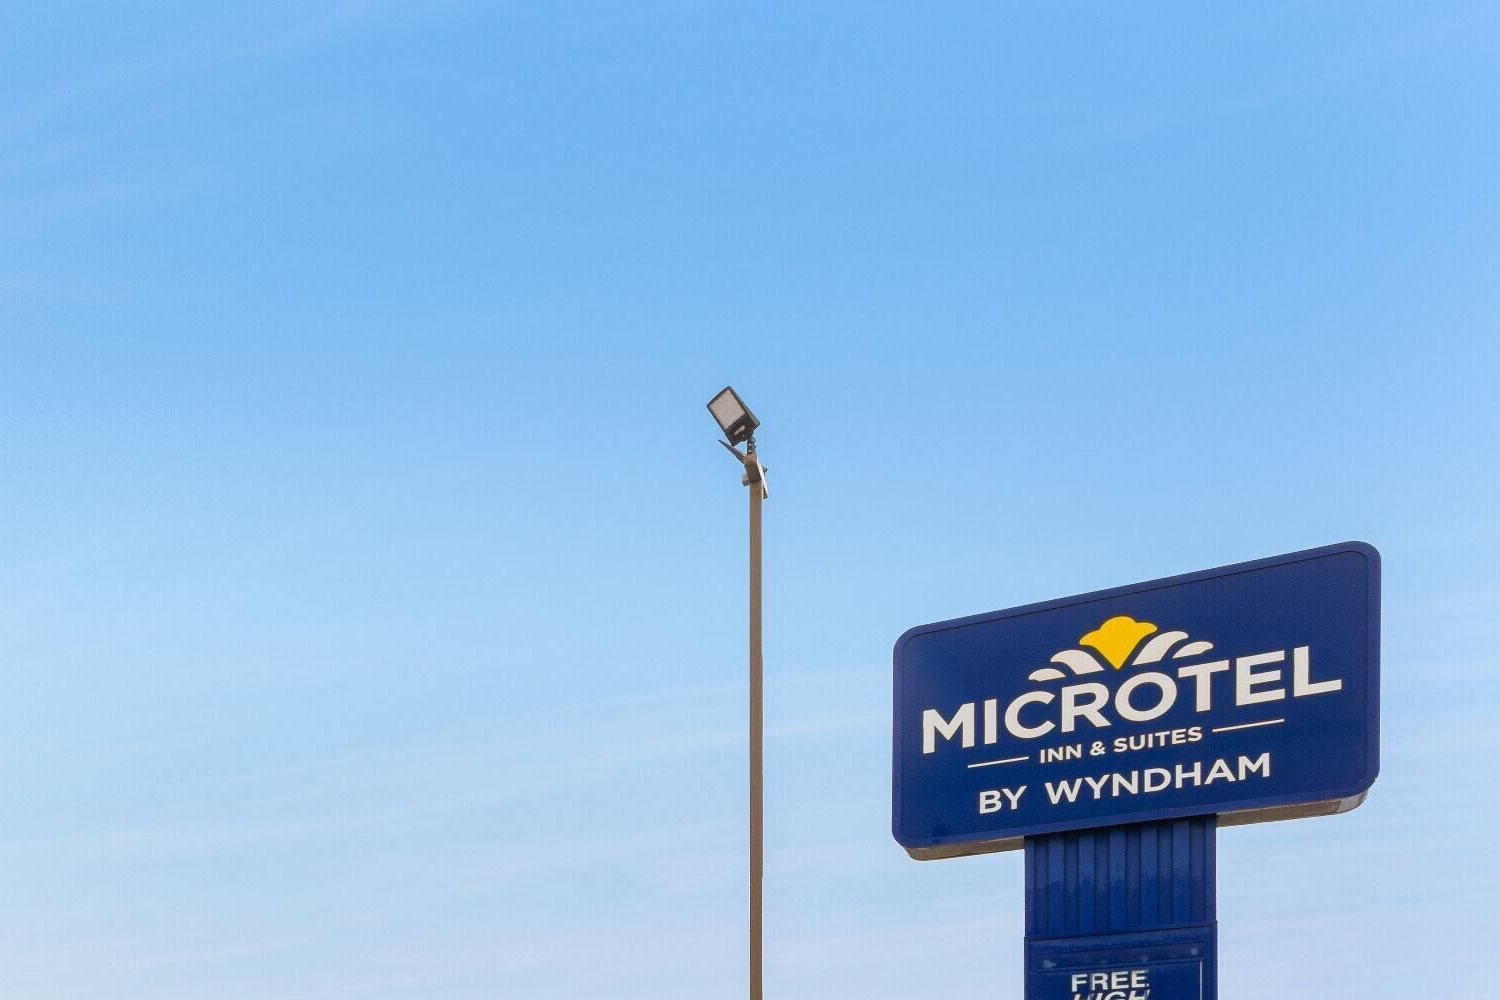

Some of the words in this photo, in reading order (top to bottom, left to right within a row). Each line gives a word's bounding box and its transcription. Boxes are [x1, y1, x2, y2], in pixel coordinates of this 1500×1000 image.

[922, 645, 1342, 754] MICROTEL
[1039, 743, 1082, 764] INN
[1090, 740, 1106, 756] &
[1113, 726, 1203, 753] SUITES
[979, 786, 1027, 814] BY
[1045, 752, 1271, 805] WYNDHAM
[1071, 969, 1149, 992] FREE
